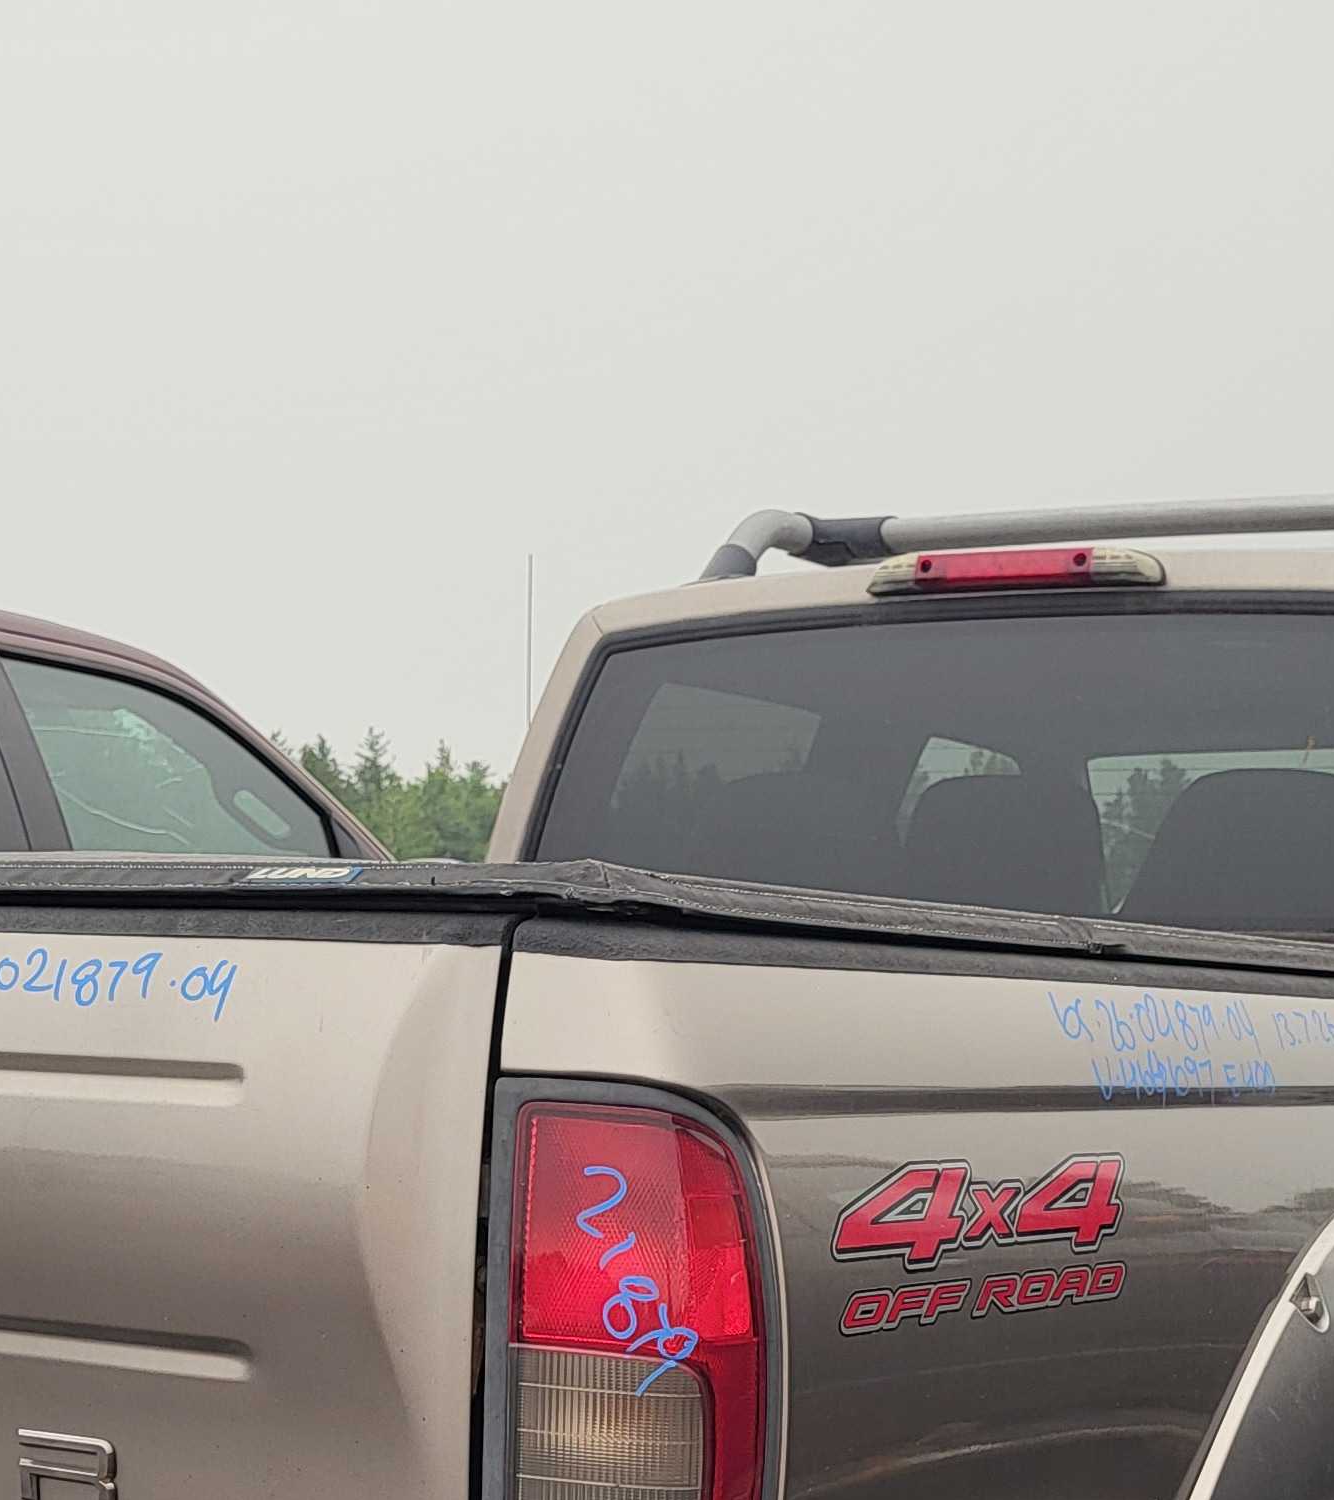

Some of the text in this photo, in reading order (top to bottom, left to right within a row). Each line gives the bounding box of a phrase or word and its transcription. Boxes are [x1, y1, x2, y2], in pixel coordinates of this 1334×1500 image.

[831, 1151, 1126, 1274] 4x4
[838, 1260, 1128, 1337] OFF ROAD
